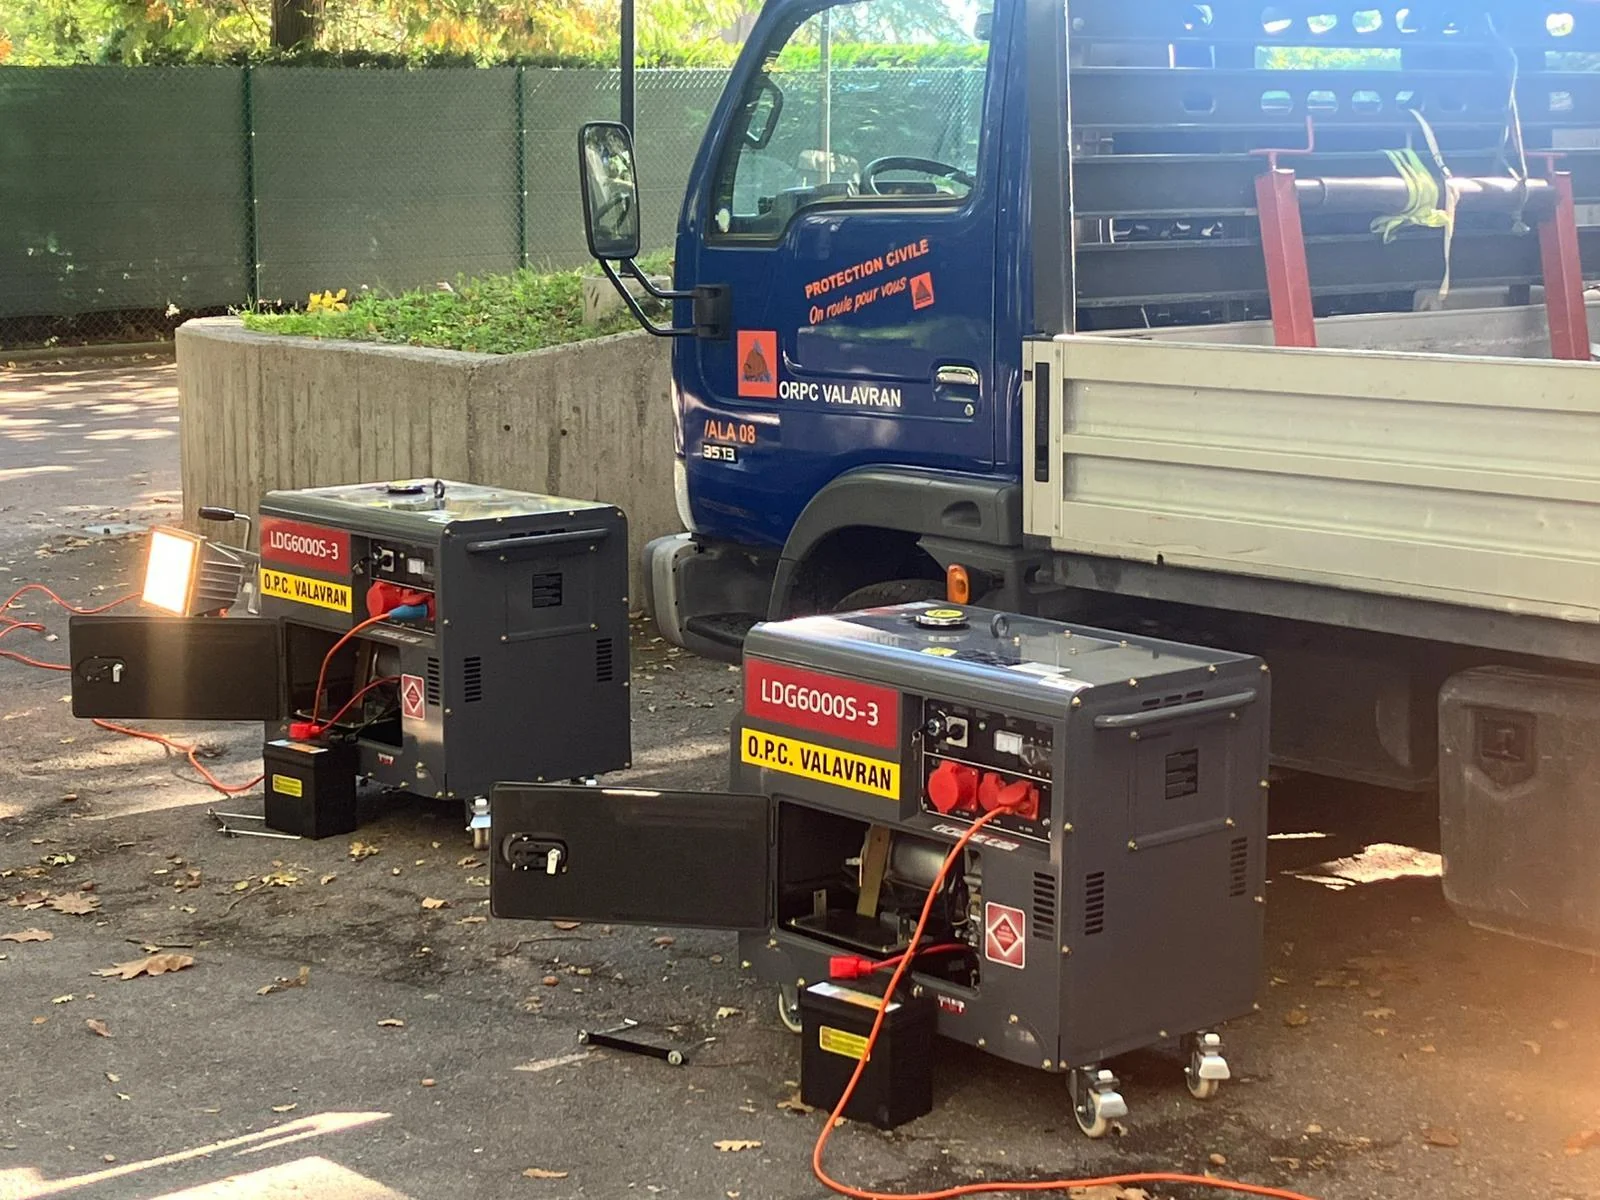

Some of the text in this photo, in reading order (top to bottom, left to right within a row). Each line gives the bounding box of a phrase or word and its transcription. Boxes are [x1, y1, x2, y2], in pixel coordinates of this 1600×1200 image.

[804, 238, 930, 299] PROTECTION CIVILE
[809, 276, 908, 325] On roule pour vous
[778, 380, 902, 408] ORPC VALAVRAN
[739, 423, 756, 444] 08
[270, 530, 339, 561] LDG6000S-3
[264, 573, 347, 608] O.P.C. VALAVRAN
[761, 678, 879, 727] LDG6000S-3
[748, 735, 892, 791] O.P.C. VALAVRAN
